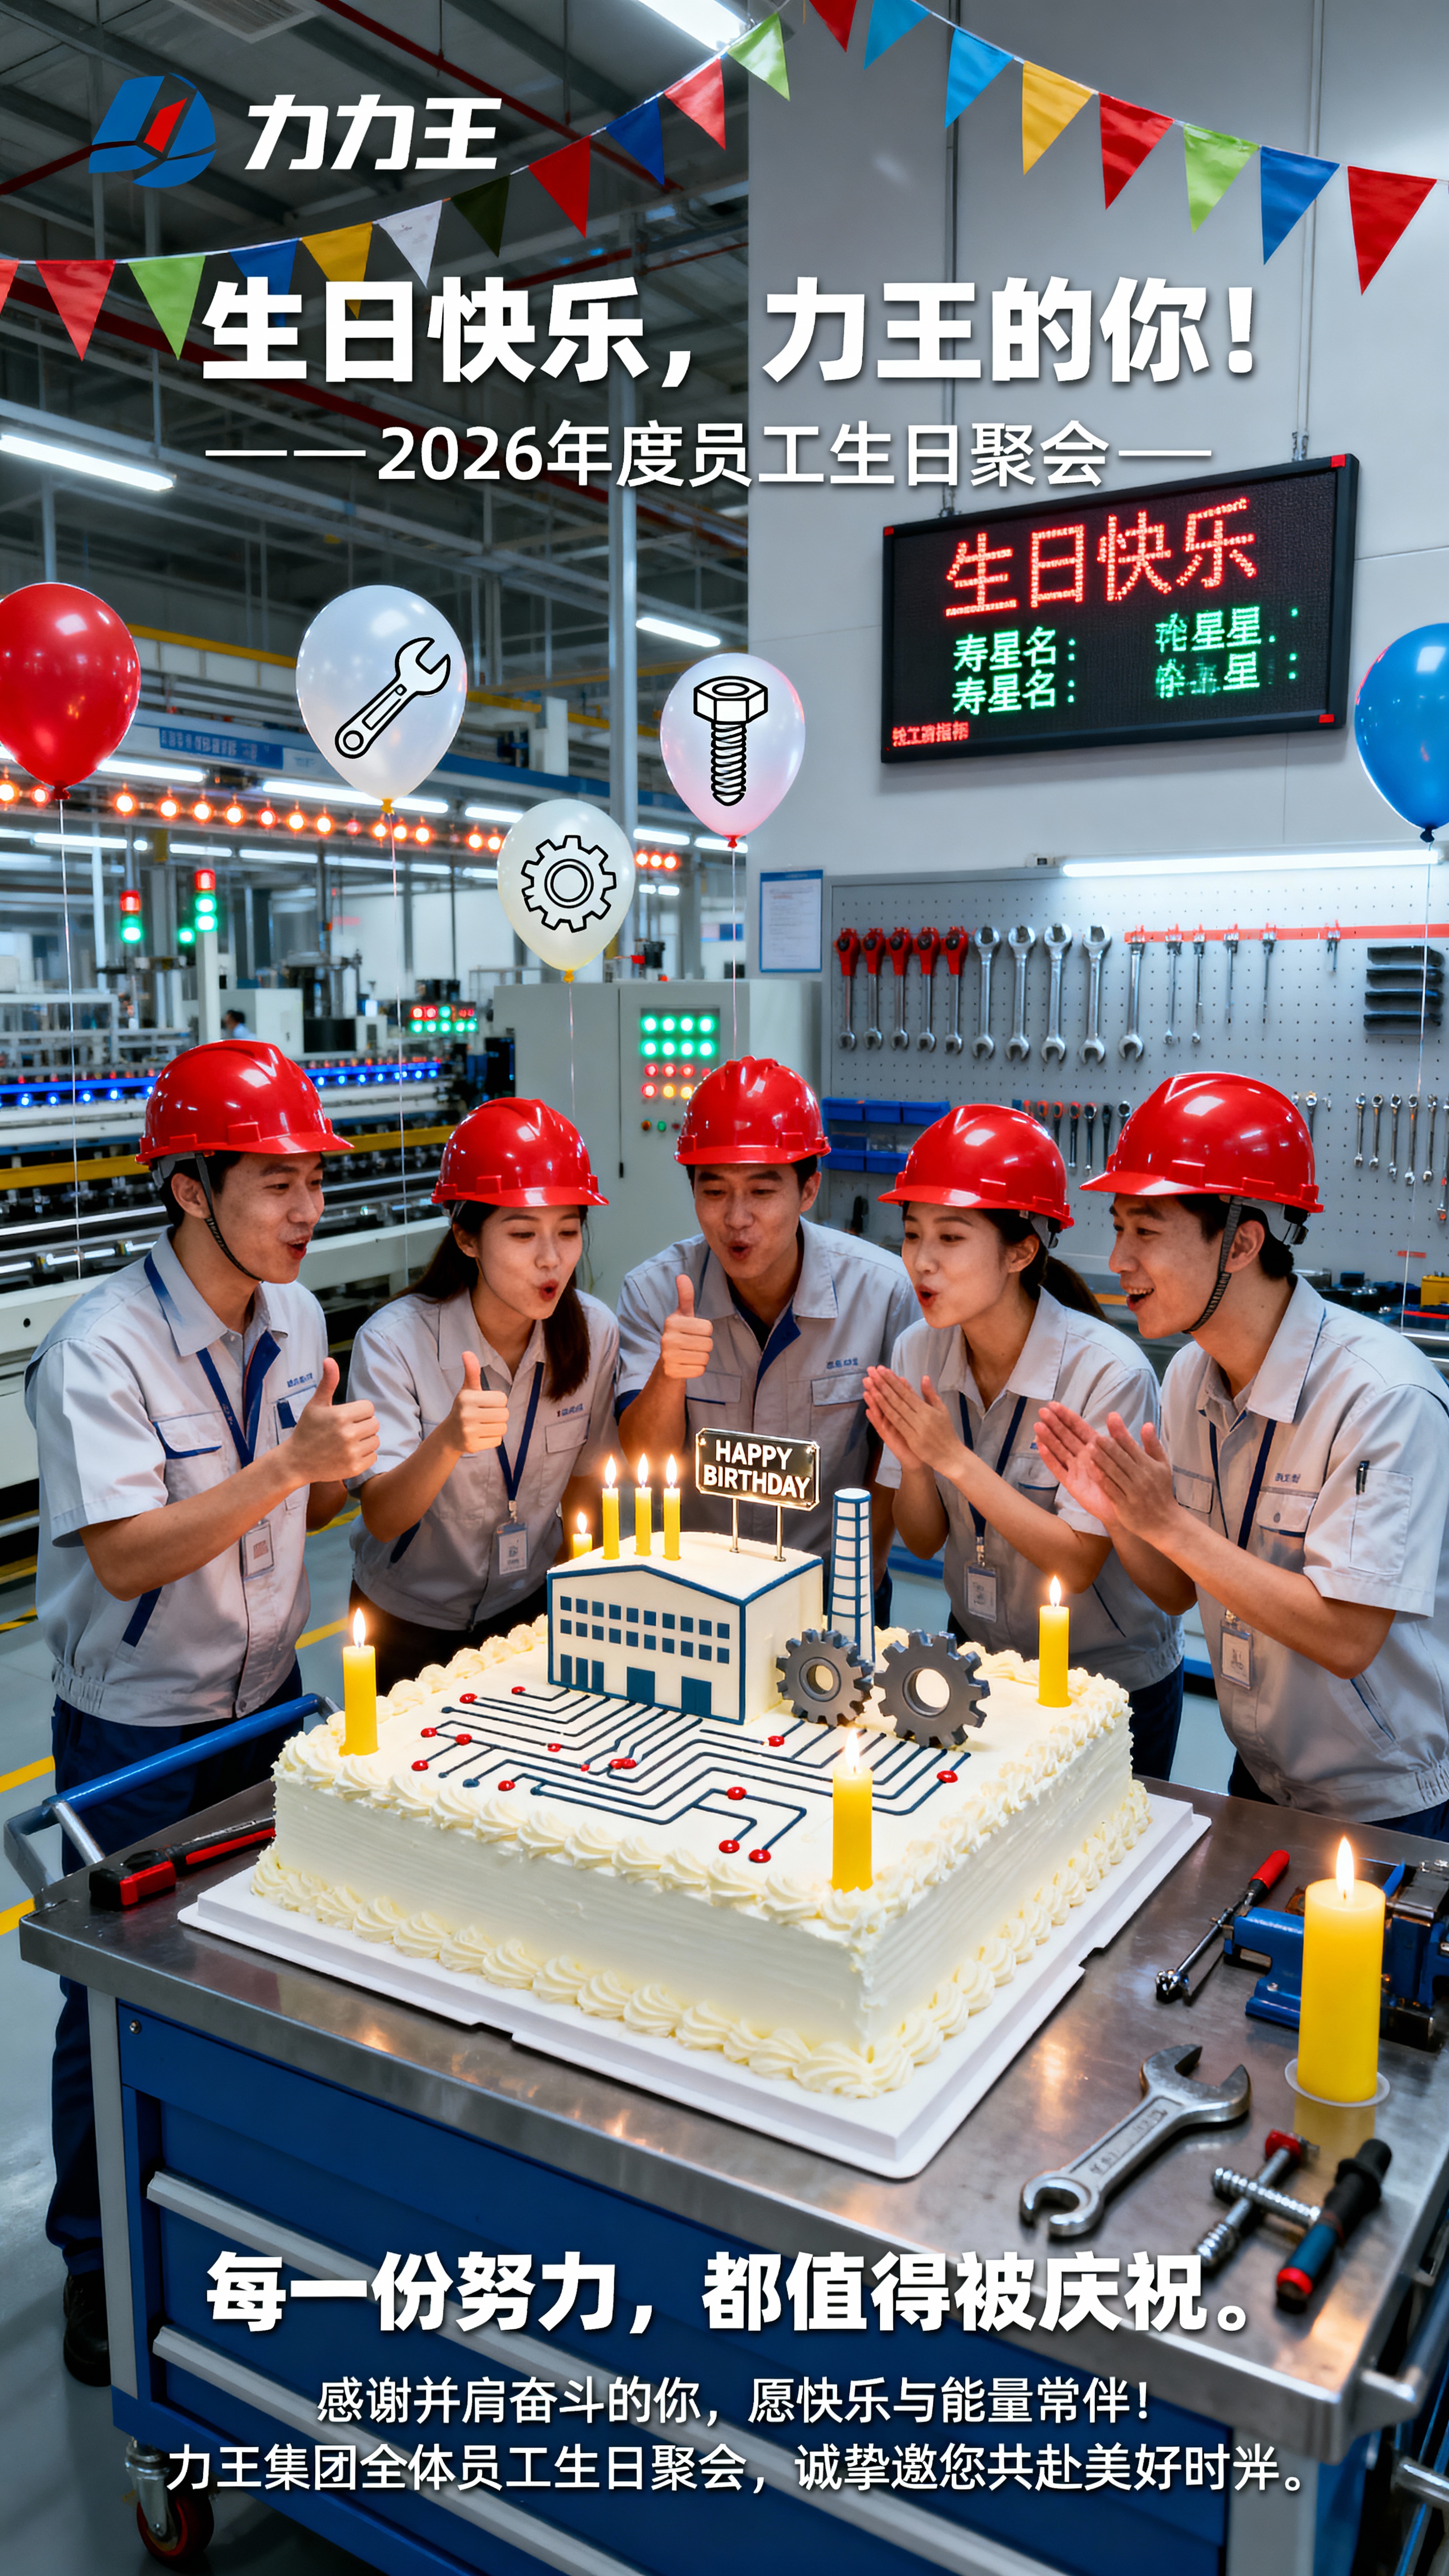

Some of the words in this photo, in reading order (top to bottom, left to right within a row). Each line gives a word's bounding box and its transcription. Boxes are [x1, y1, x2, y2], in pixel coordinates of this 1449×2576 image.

[944, 496, 1258, 618] 生日快乐
[715, 1439, 793, 1470] HAPPY
[703, 1464, 811, 1499] BIRTHDAY
